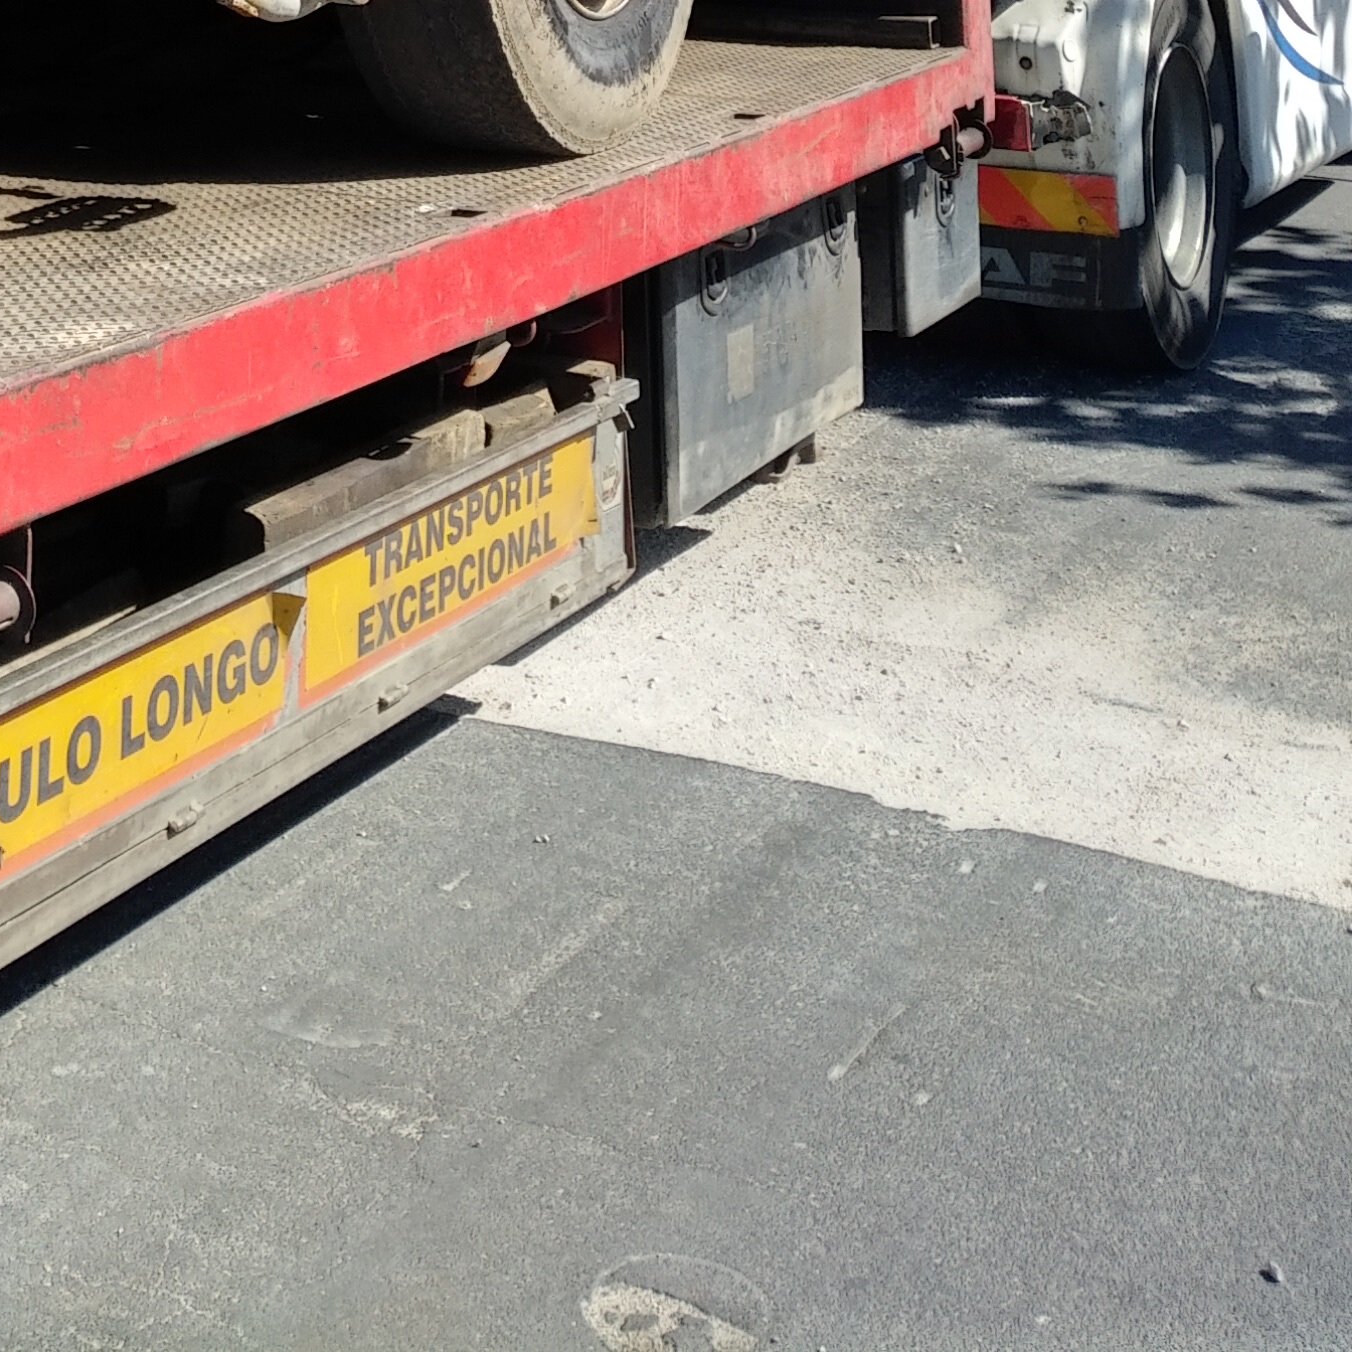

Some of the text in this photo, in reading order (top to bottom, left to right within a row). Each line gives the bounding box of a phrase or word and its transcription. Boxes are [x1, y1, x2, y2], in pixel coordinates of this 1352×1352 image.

[980, 246, 1087, 288] AF
[357, 511, 557, 659] EXCEPCIONAL
[364, 454, 554, 588] TRANSPORTE
[120, 622, 280, 760] LONGO
